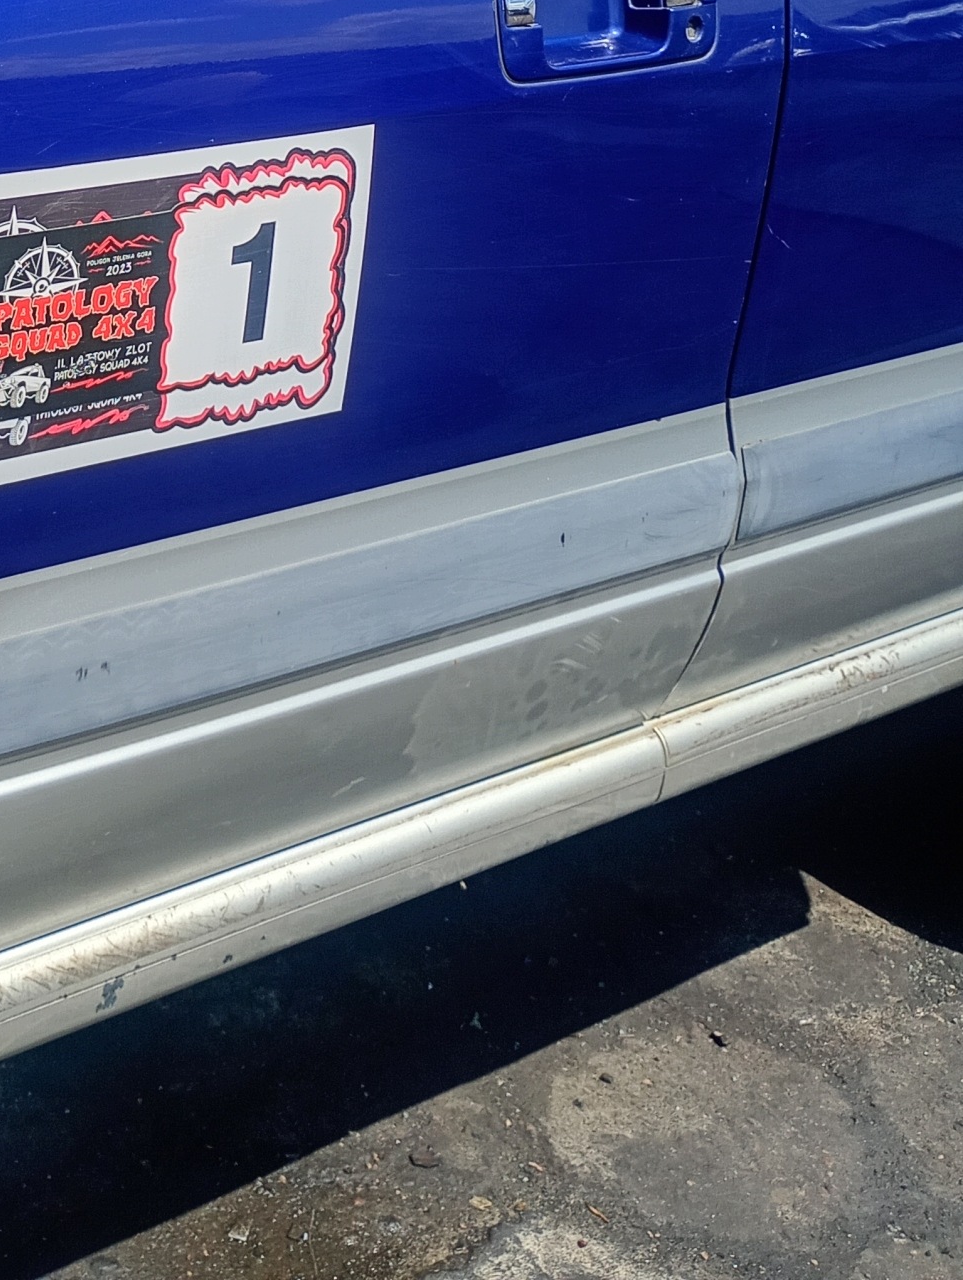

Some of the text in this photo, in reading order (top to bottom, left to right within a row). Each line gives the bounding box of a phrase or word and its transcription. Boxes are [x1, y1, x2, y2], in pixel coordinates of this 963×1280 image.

[86, 257, 111, 267] POLIGON
[105, 262, 132, 277] 2023
[230, 220, 277, 344] 1
[92, 307, 156, 342] 4X4
[125, 341, 153, 357] ZLOT
[99, 358, 131, 373] SQUAD
[131, 355, 149, 366] 4X4
